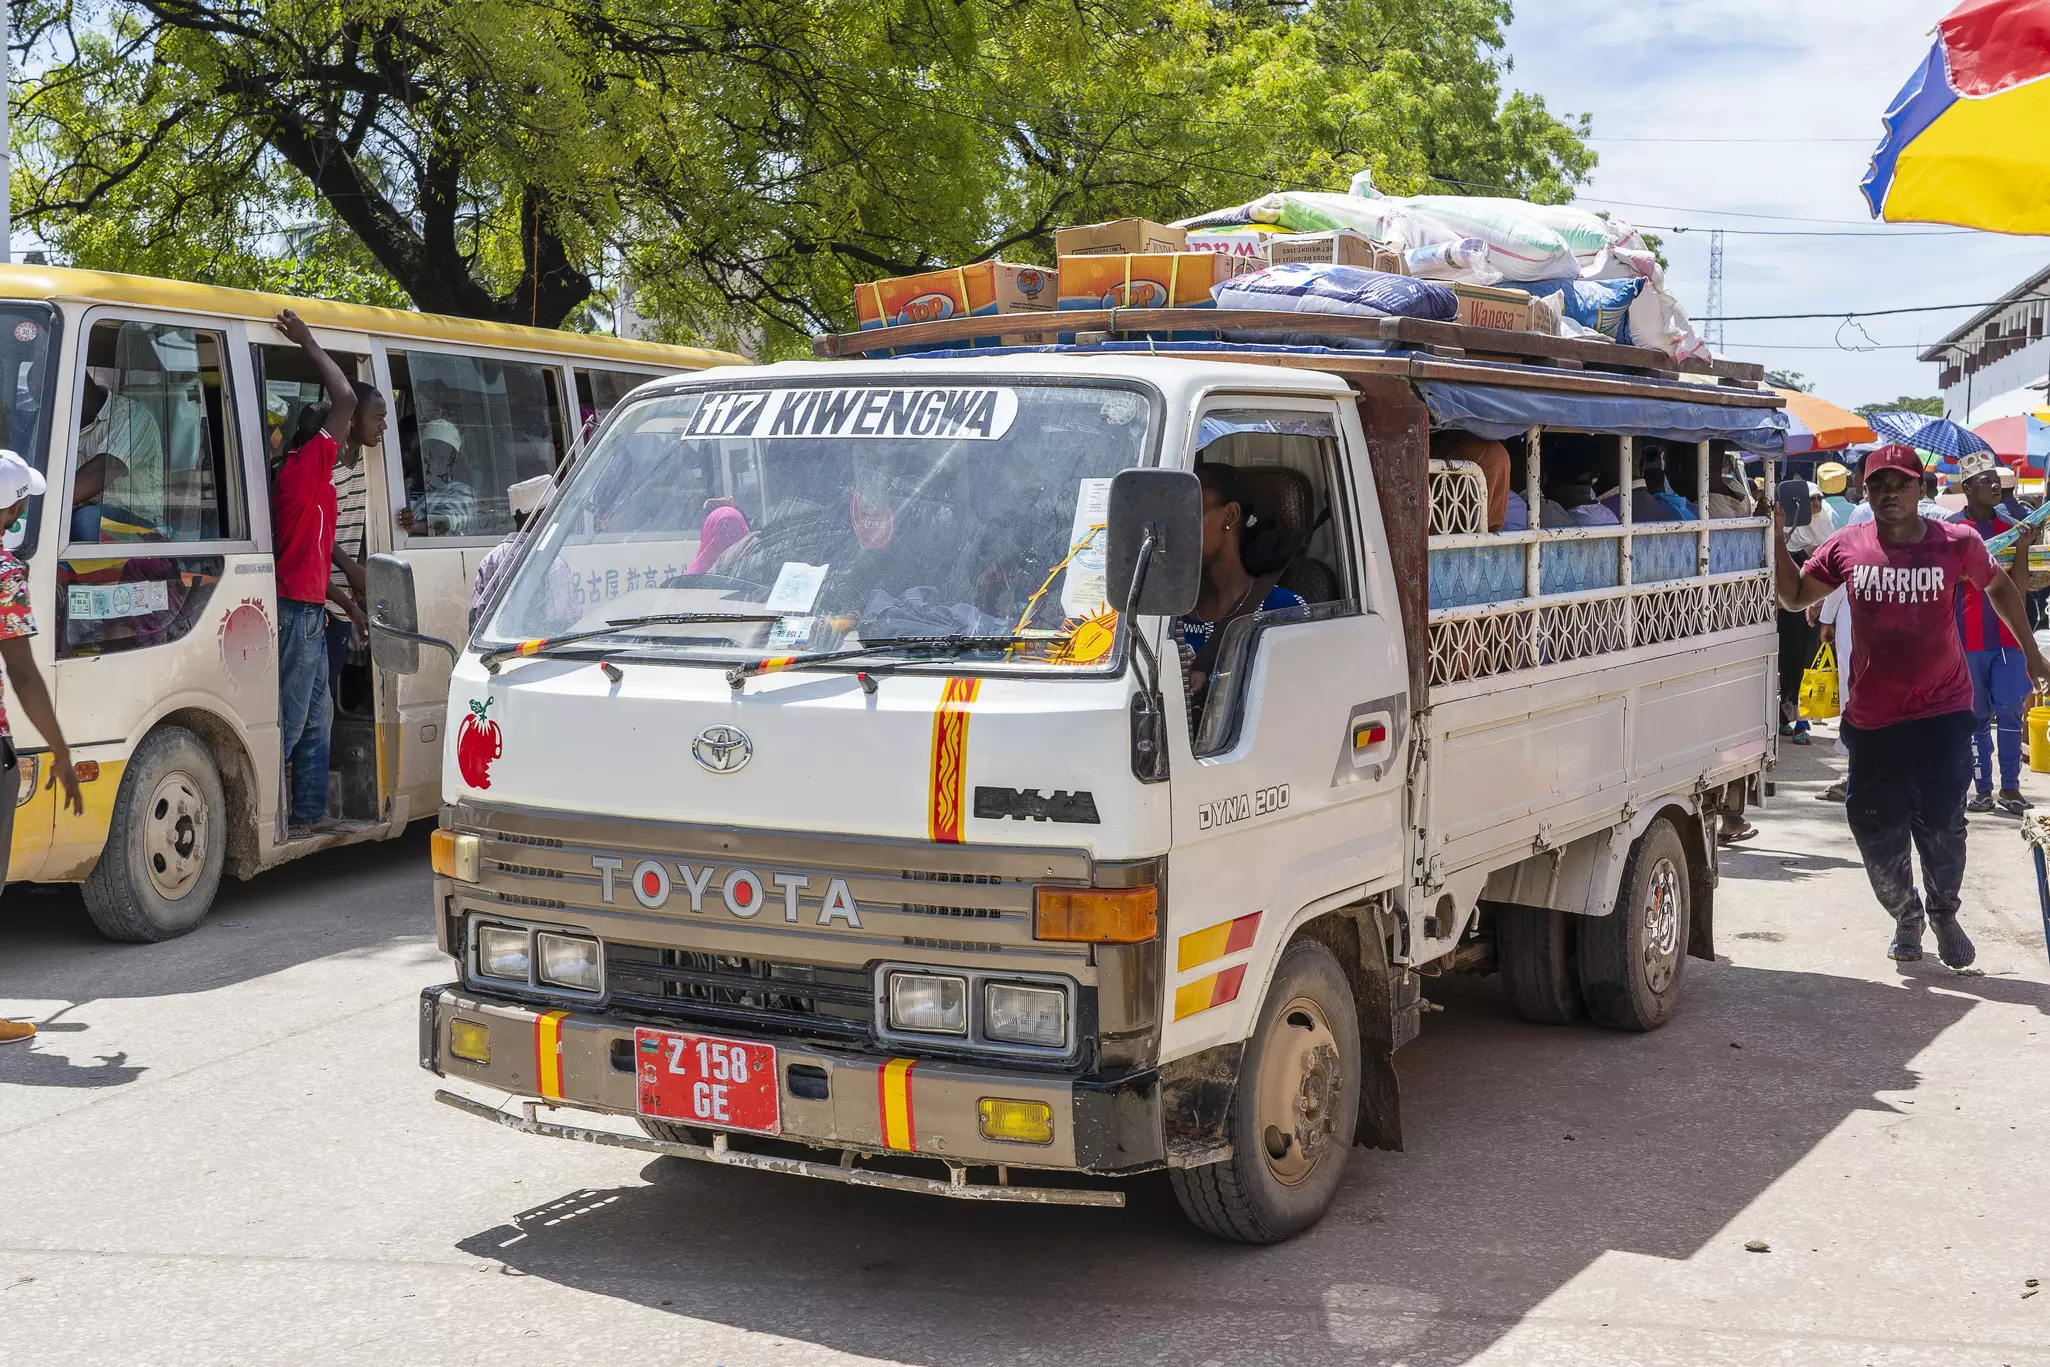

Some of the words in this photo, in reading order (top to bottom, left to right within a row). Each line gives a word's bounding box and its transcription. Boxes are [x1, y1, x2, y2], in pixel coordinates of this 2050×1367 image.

[769, 390, 999, 437] KIWENGWA
[1853, 564, 1945, 592] WARRIOR
[1855, 589, 1939, 604] FOOTBALL
[1199, 794, 1250, 830] DYNA
[1255, 783, 1290, 816] 200
[592, 855, 864, 929] TOYOTA
[667, 1038, 686, 1075] Z
[696, 1042, 748, 1084] 158
[643, 1094, 661, 1107] EAZ
[693, 1081, 730, 1121] GE
